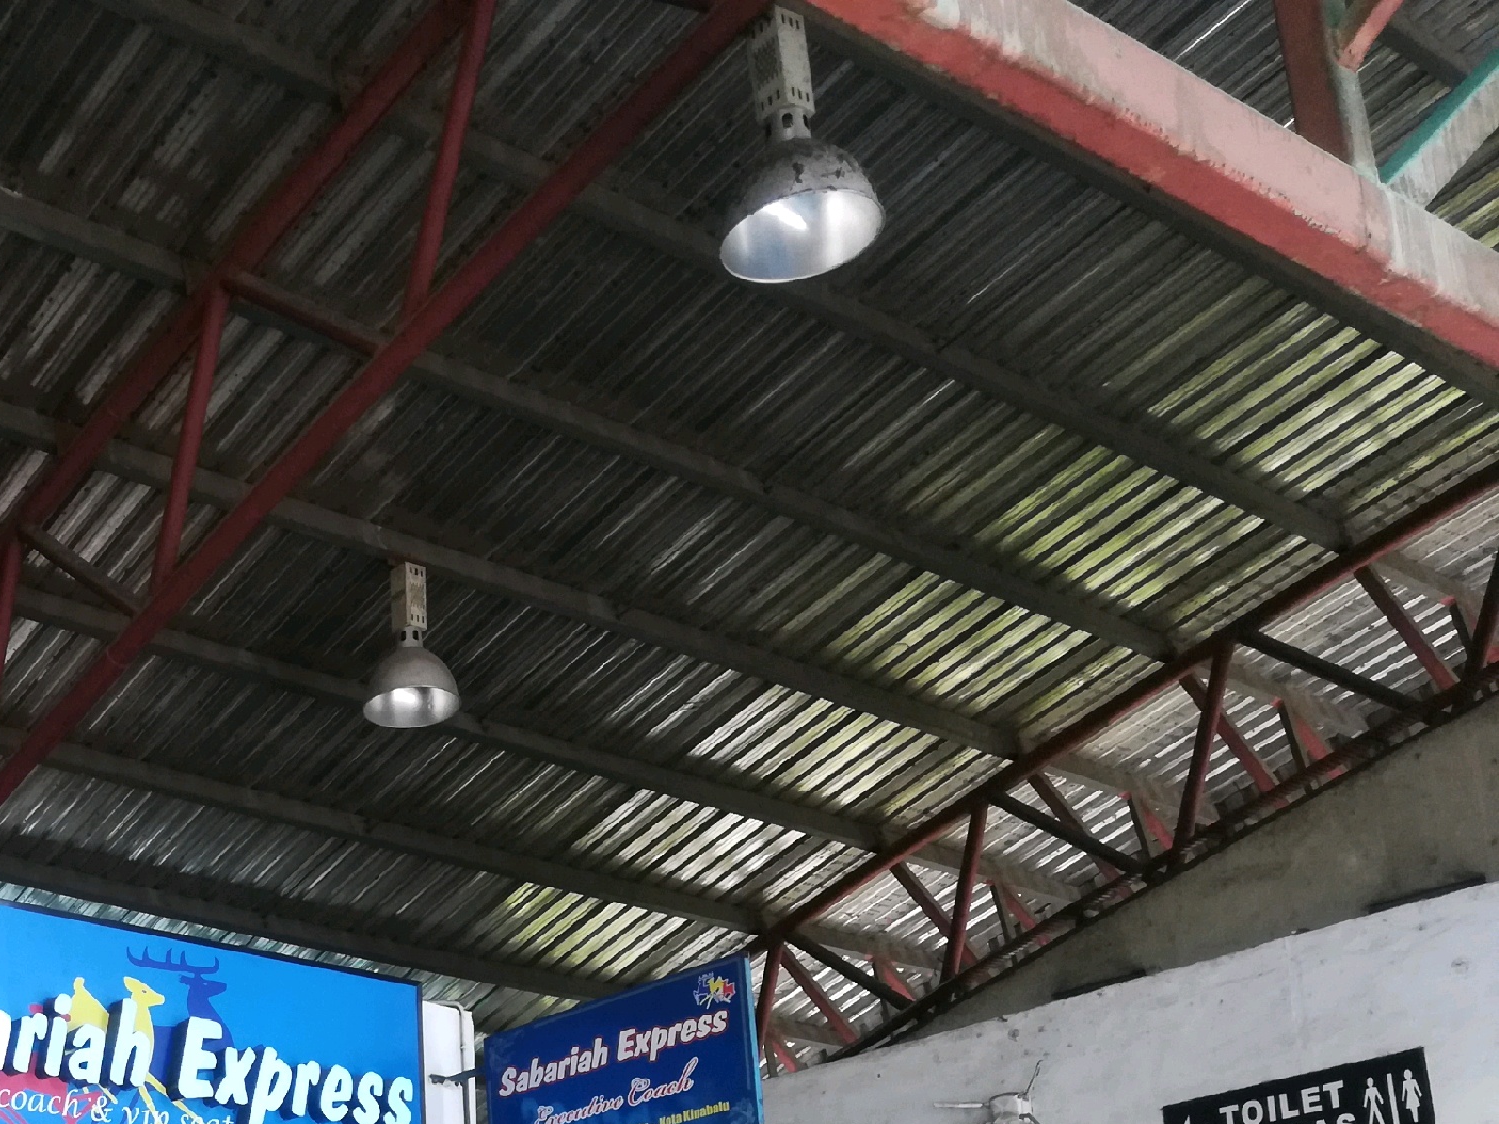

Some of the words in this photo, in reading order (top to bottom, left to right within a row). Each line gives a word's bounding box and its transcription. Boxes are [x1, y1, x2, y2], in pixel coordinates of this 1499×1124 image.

[499, 1038, 609, 1097] Sabariah
[617, 1010, 729, 1062] Express
[627, 1056, 699, 1107] Coach
[90, 1099, 112, 1124] &
